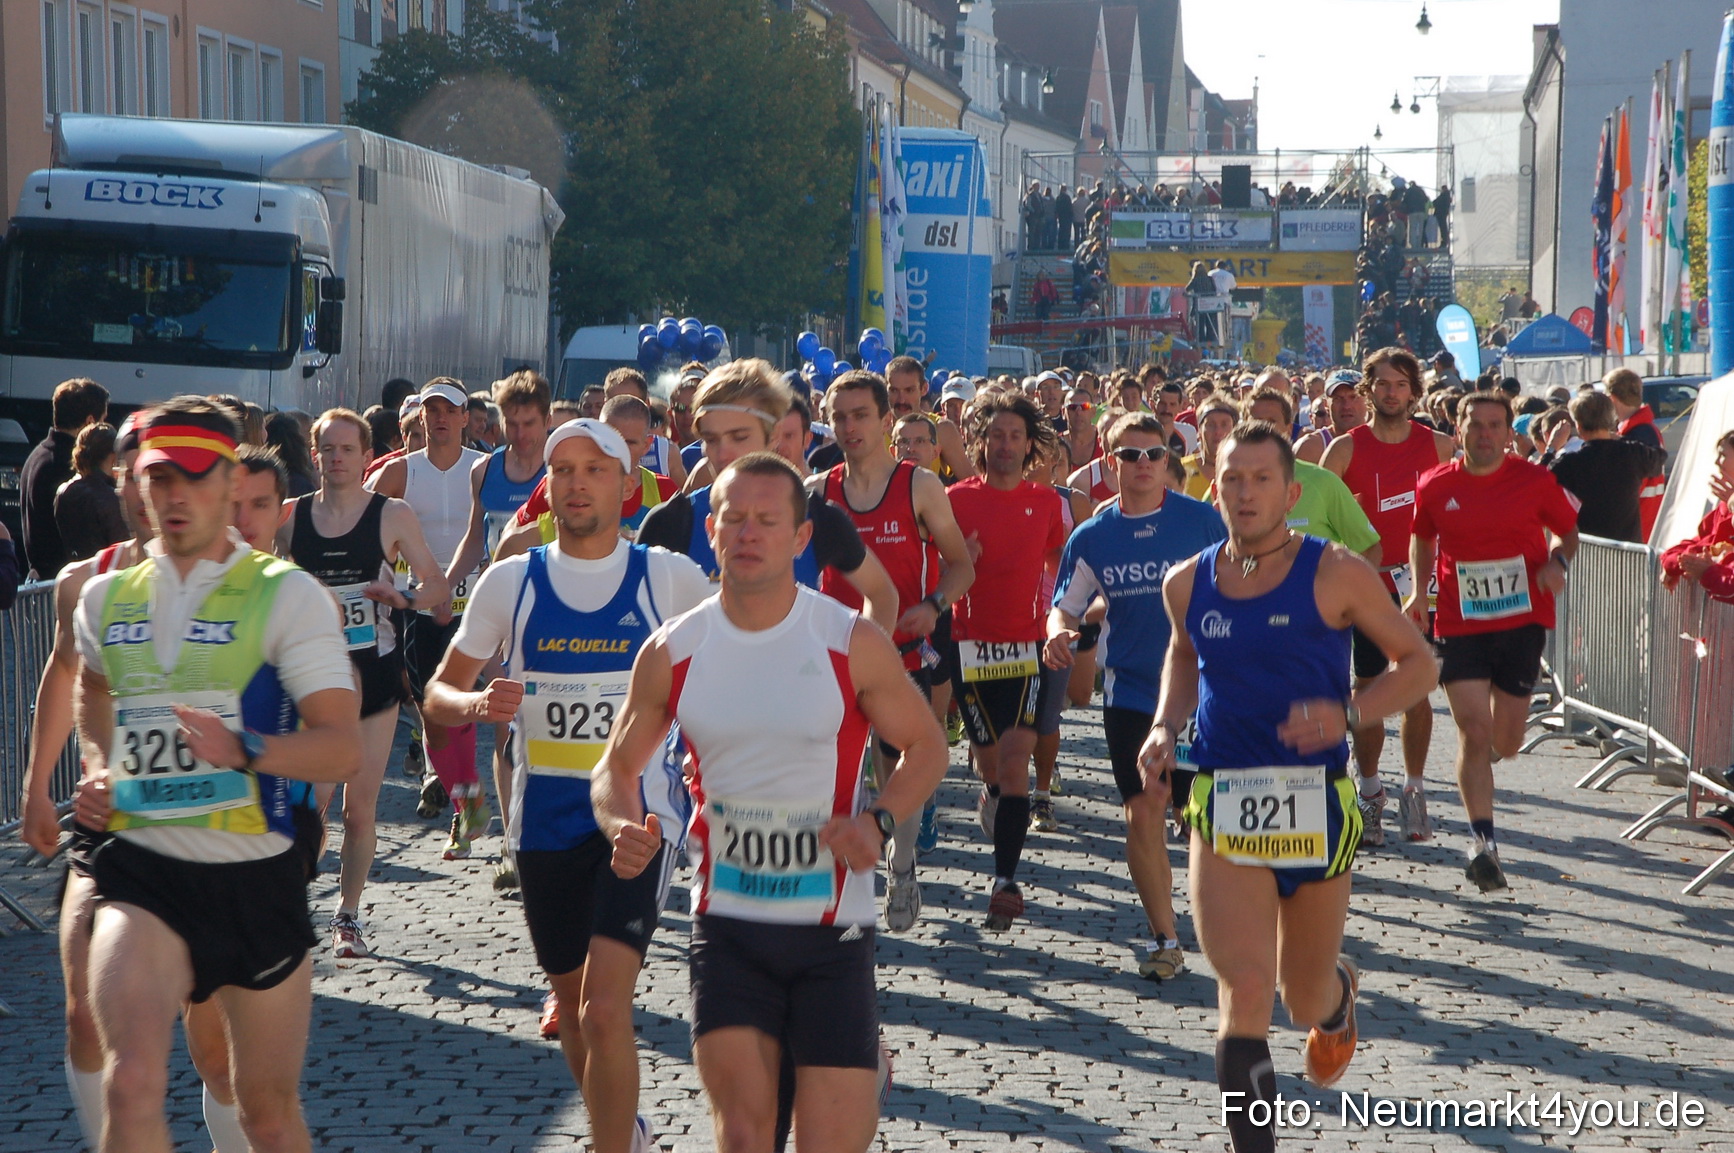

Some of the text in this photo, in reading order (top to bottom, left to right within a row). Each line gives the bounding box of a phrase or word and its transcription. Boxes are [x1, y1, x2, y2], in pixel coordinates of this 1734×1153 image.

[902, 155, 965, 198] axi
[84, 179, 225, 210] BOCK
[924, 220, 960, 247] dsl
[1147, 219, 1239, 240] BOCK
[1300, 221, 1356, 232] PFLEIDERER
[875, 535, 907, 544] Erlangen
[884, 520, 899, 534] LG
[1103, 559, 1183, 586] SYSCA
[1466, 574, 1519, 599] 3117
[113, 601, 149, 618] TEA
[537, 638, 631, 654] LAC QUELLE
[975, 664, 1026, 680] Thomas
[546, 701, 614, 740] 923
[122, 729, 198, 776] 326
[1239, 794, 1297, 832] 821
[725, 823, 818, 872] 2000
[1226, 833, 1315, 858] Wolfgang
